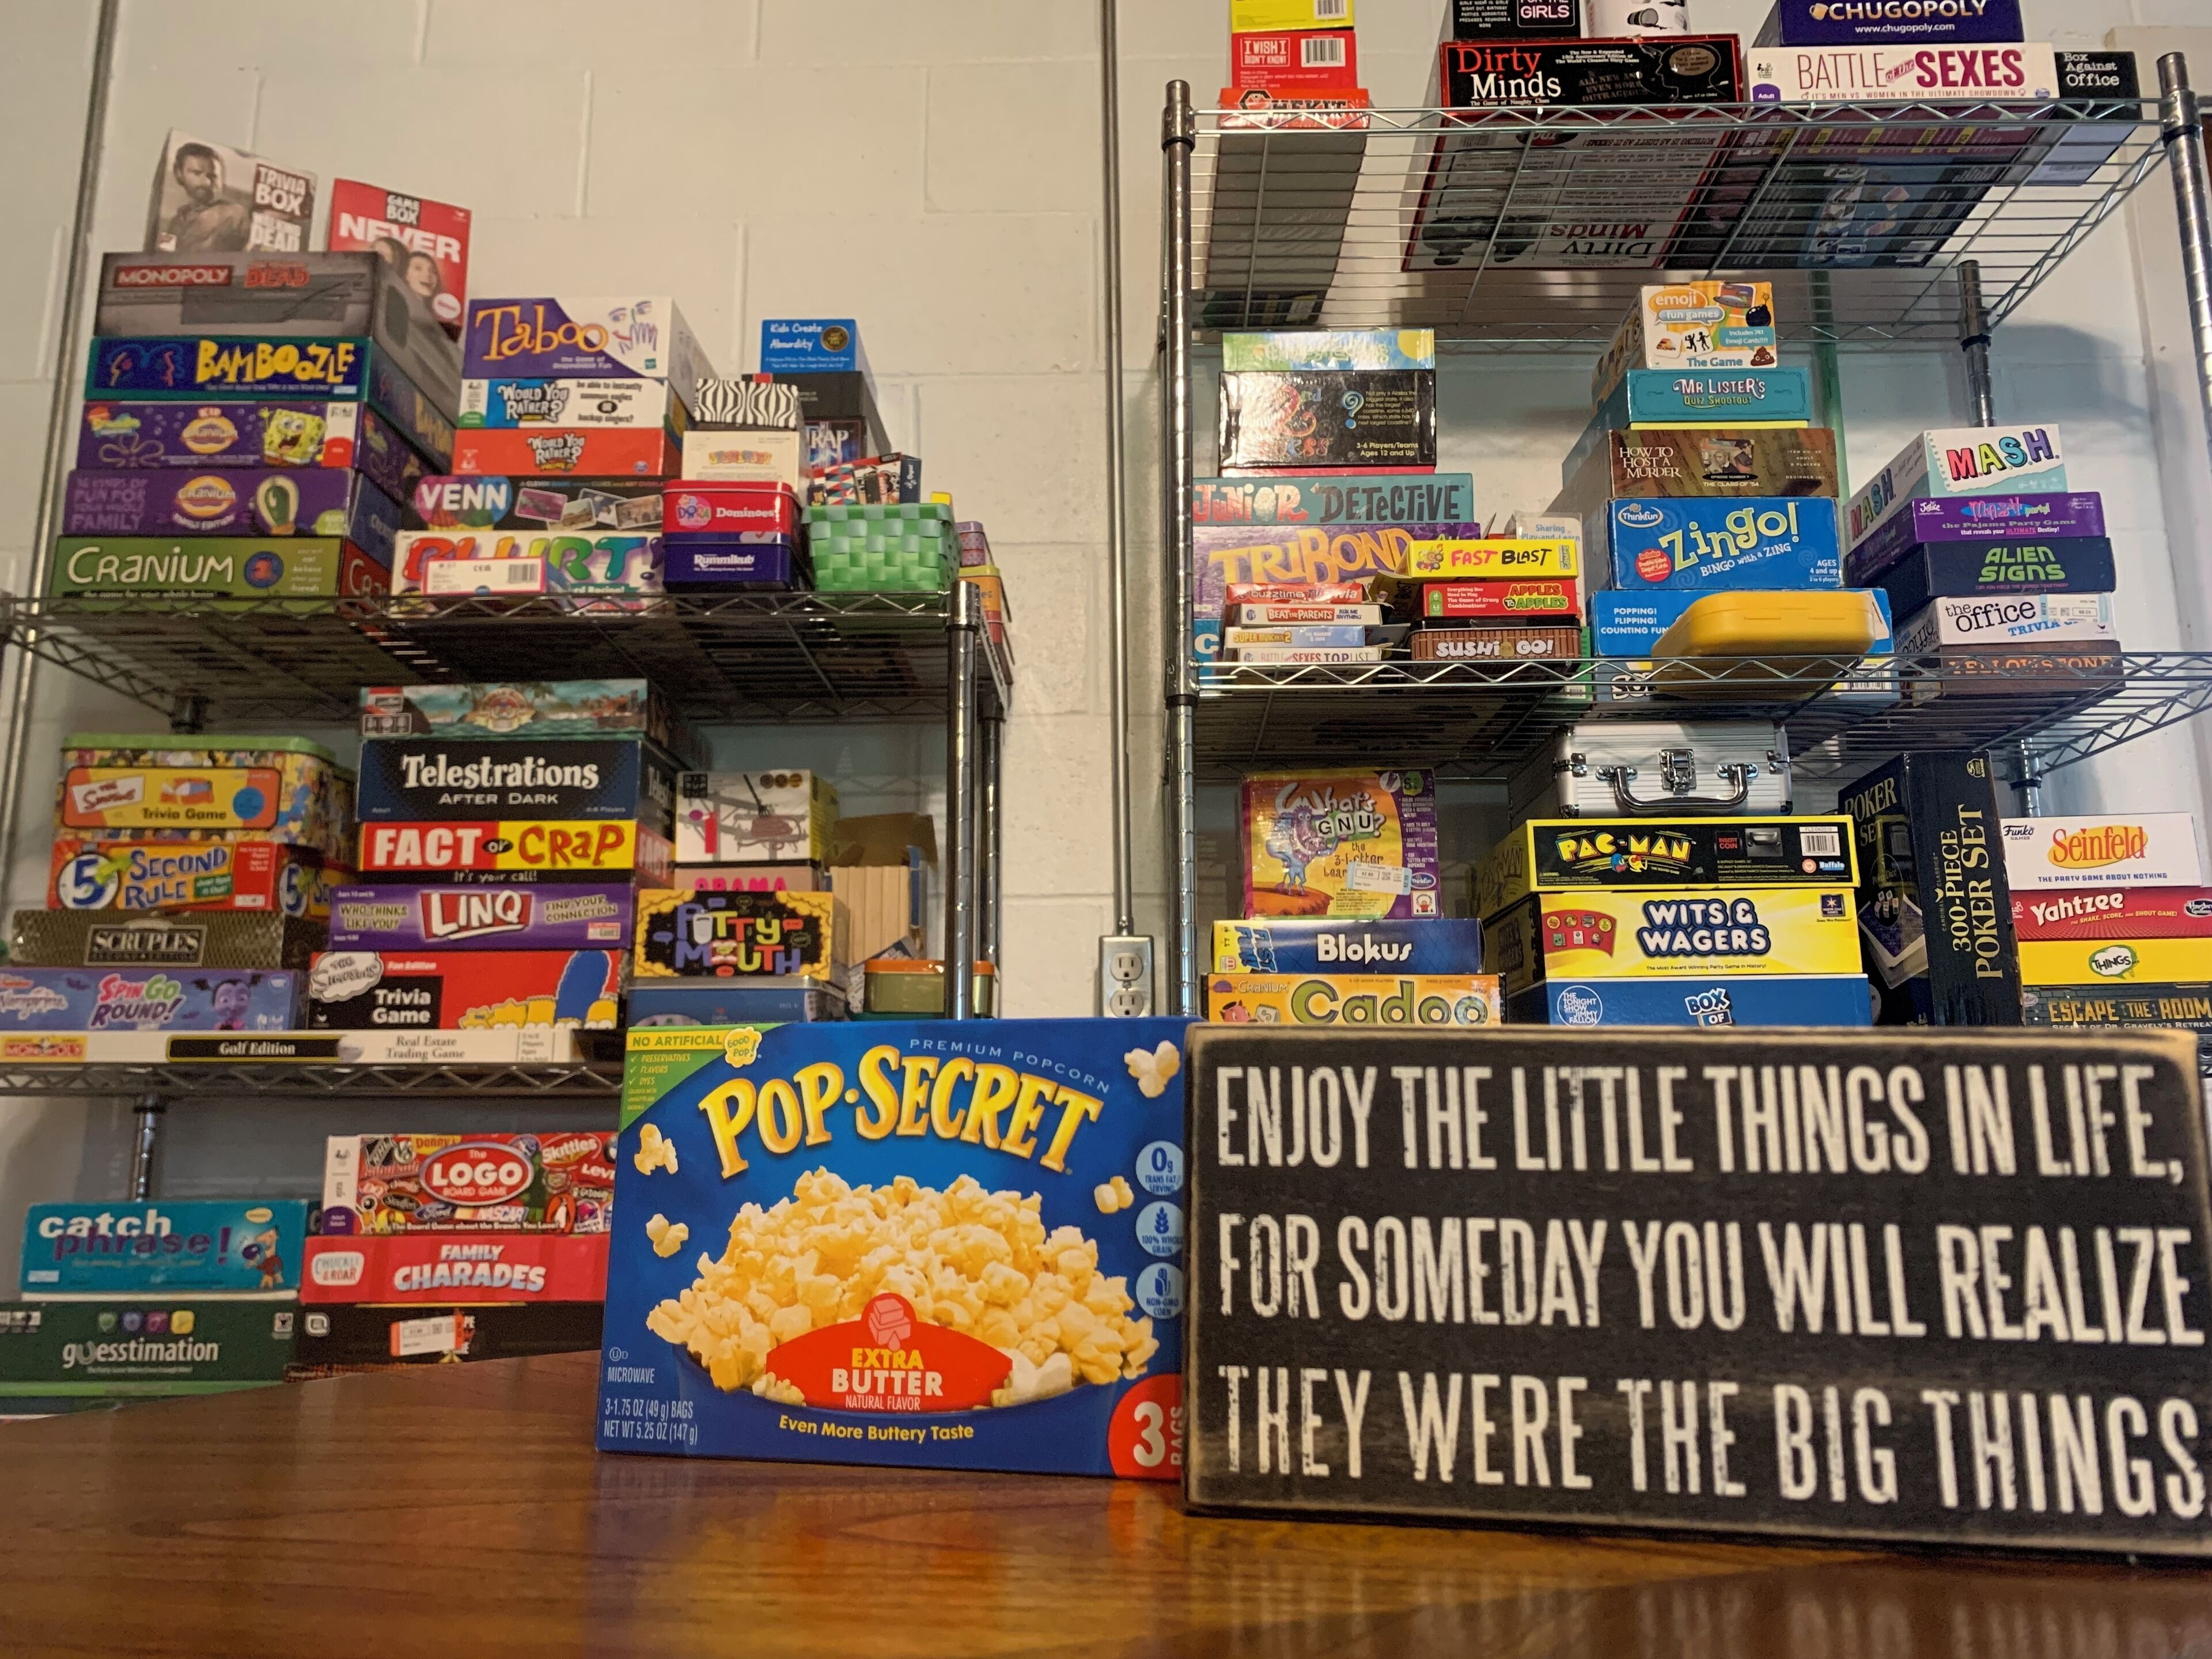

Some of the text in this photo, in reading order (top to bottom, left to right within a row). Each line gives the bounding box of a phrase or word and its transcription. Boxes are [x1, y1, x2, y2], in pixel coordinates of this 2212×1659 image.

[1521, 5, 1570, 18] GIRLS
[1855, 22, 1956, 35] www.chugopoly.com
[1244, 40, 1287, 54] I WISH I
[1457, 47, 1541, 78] Dirty
[2064, 52, 2088, 62] Box
[1798, 53, 1884, 90] BATTLE
[1896, 59, 1915, 77] the
[1915, 49, 2025, 88] SEXES
[2066, 62, 2116, 73] Against
[1471, 71, 1562, 99] Minds
[2067, 73, 2119, 87] Office
[255, 183, 302, 216] BOX
[118, 268, 229, 285] MONOPOLY
[1655, 292, 1698, 308] emoji
[1666, 309, 1719, 320] fun games
[475, 305, 608, 361] Taboo
[196, 340, 355, 383] BAMBOOZLE
[1687, 357, 1743, 367] The Game
[498, 383, 541, 402] WOULD
[544, 382, 569, 401] YOU
[1684, 396, 1752, 405] QUIZ SHOOTOUT
[1619, 446, 1673, 457] HOW TO
[1623, 457, 1671, 467] HOST A
[1627, 467, 1682, 478] MURDER
[421, 483, 507, 511] VENN
[1536, 524, 1565, 533] Sharing
[1658, 502, 1800, 571] Zingo!
[694, 554, 755, 567] Rummikub
[1452, 548, 1552, 567] FAST BLAST
[1985, 547, 2055, 563] ALIEN
[1979, 564, 2066, 582] SIGNS
[1251, 589, 1305, 600] buzztime
[1510, 585, 1560, 596] APPLES
[1505, 597, 1568, 608] To APPLES
[1268, 609, 1289, 620] BEAT
[1298, 609, 1332, 620] PARENTS
[1946, 601, 2036, 632] the office
[2008, 621, 2059, 637] TRIVIA
[1435, 639, 1554, 657] SUSHI GO!
[402, 755, 599, 790] Telestrations
[439, 793, 559, 805] AFTER DARK
[143, 808, 226, 820] Trivia Game
[1958, 803, 1988, 869] SET
[2003, 824, 2035, 836] Funko
[374, 828, 482, 866] FACT
[488, 840, 506, 853] or
[1556, 832, 1691, 862] PAC-MAN
[2053, 826, 2146, 863] Seinfeld
[130, 847, 228, 881] SECOND
[73, 858, 107, 906] 5
[1941, 829, 1971, 952] 300-PIECE
[126, 880, 186, 908] RULE
[545, 895, 606, 911] FIND YOUR
[340, 905, 407, 916] WHO THINKS
[430, 890, 522, 937] LINQ
[546, 905, 616, 921] CONNECTION
[1647, 903, 1754, 925] WITS &
[2030, 892, 2124, 926] Yahtzee
[347, 918, 366, 929] LIKE
[1968, 878, 2003, 979] POKER
[94, 931, 199, 952] SCRUPLES
[1317, 934, 1413, 965] Blokus
[1642, 929, 1768, 953] WAGERS
[100, 974, 180, 1001] SPIN GO
[374, 989, 431, 1005] Trivia
[1291, 979, 1489, 1025] Cadoo
[1685, 989, 1730, 1014] BOX
[2048, 998, 2212, 1022] ESCAPE THE ROOM
[92, 997, 185, 1027] ROUND!
[373, 1007, 430, 1024] Game
[1709, 1014, 1725, 1024] OF
[219, 1042, 295, 1056] Golf Edition
[396, 1036, 457, 1047] Real Estate
[633, 1035, 722, 1047] NO ARTIFICIAL
[727, 1036, 749, 1048] GOOD
[385, 1048, 465, 1060] Trading Game
[641, 1053, 691, 1062] PRESERVATIVES
[641, 1065, 669, 1074] FLAVORS
[910, 1039, 1109, 1094] PREMIUM POPCORN
[639, 1077, 656, 1085] DYES
[1217, 1065, 2184, 1184] ENJOY THE LITTLE THINGS IN LIFE,
[432, 1162, 522, 1186] LOGO
[39, 1209, 171, 1238] catch
[54, 1226, 231, 1264] phrase!
[441, 1244, 505, 1261] FAMILY
[393, 1262, 547, 1292] CHARADES
[1219, 1213, 2205, 1345] FOR SOMEDAY YOU WILL REALIZE
[62, 1337, 219, 1369] guesstimation
[852, 1348, 924, 1369] EXTRA
[608, 1366, 655, 1384] MICROWAVE
[832, 1368, 944, 1397] BUTTER
[845, 1395, 921, 1411] NATURAL FLAVOR
[604, 1421, 698, 1445] NET WT 5.25 OZ (147 g)
[779, 1415, 974, 1444] Even More Buttery Taste
[1133, 1401, 1165, 1467] 3
[1219, 1366, 2212, 1518] THEY WERE THE BIG THINGS
